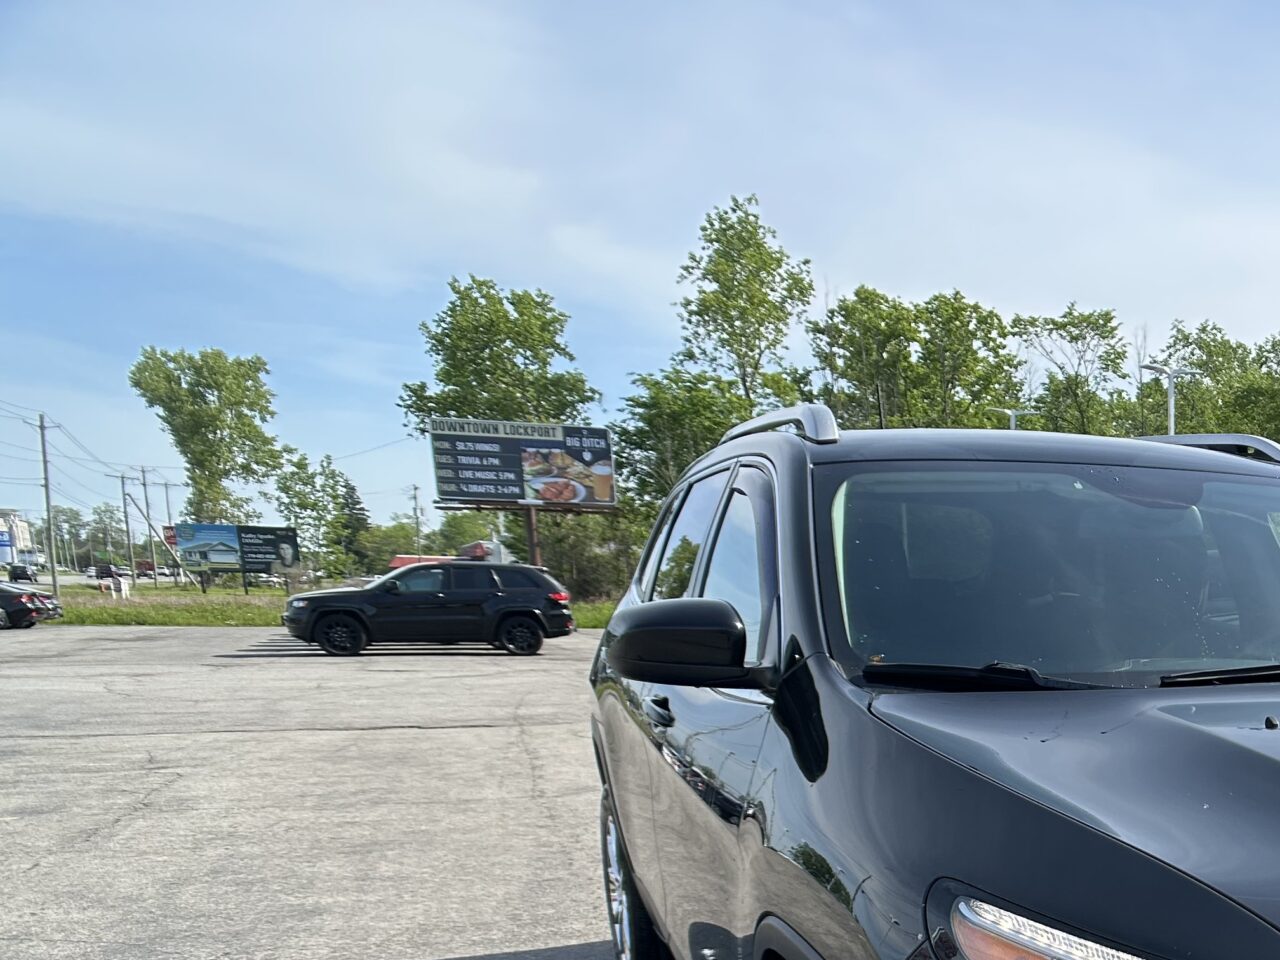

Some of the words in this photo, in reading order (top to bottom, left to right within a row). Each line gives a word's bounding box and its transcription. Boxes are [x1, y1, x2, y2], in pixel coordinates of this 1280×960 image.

[431, 420, 499, 435] DOWNTOWN
[503, 423, 557, 438] LOCKPORT
[565, 436, 581, 447] BIG
[582, 438, 606, 449] DITCH
[457, 455, 482, 465] TRIVIA
[458, 470, 475, 479] LIVE
[475, 471, 498, 480] MUSIC
[468, 484, 496, 494] DRAFTS
